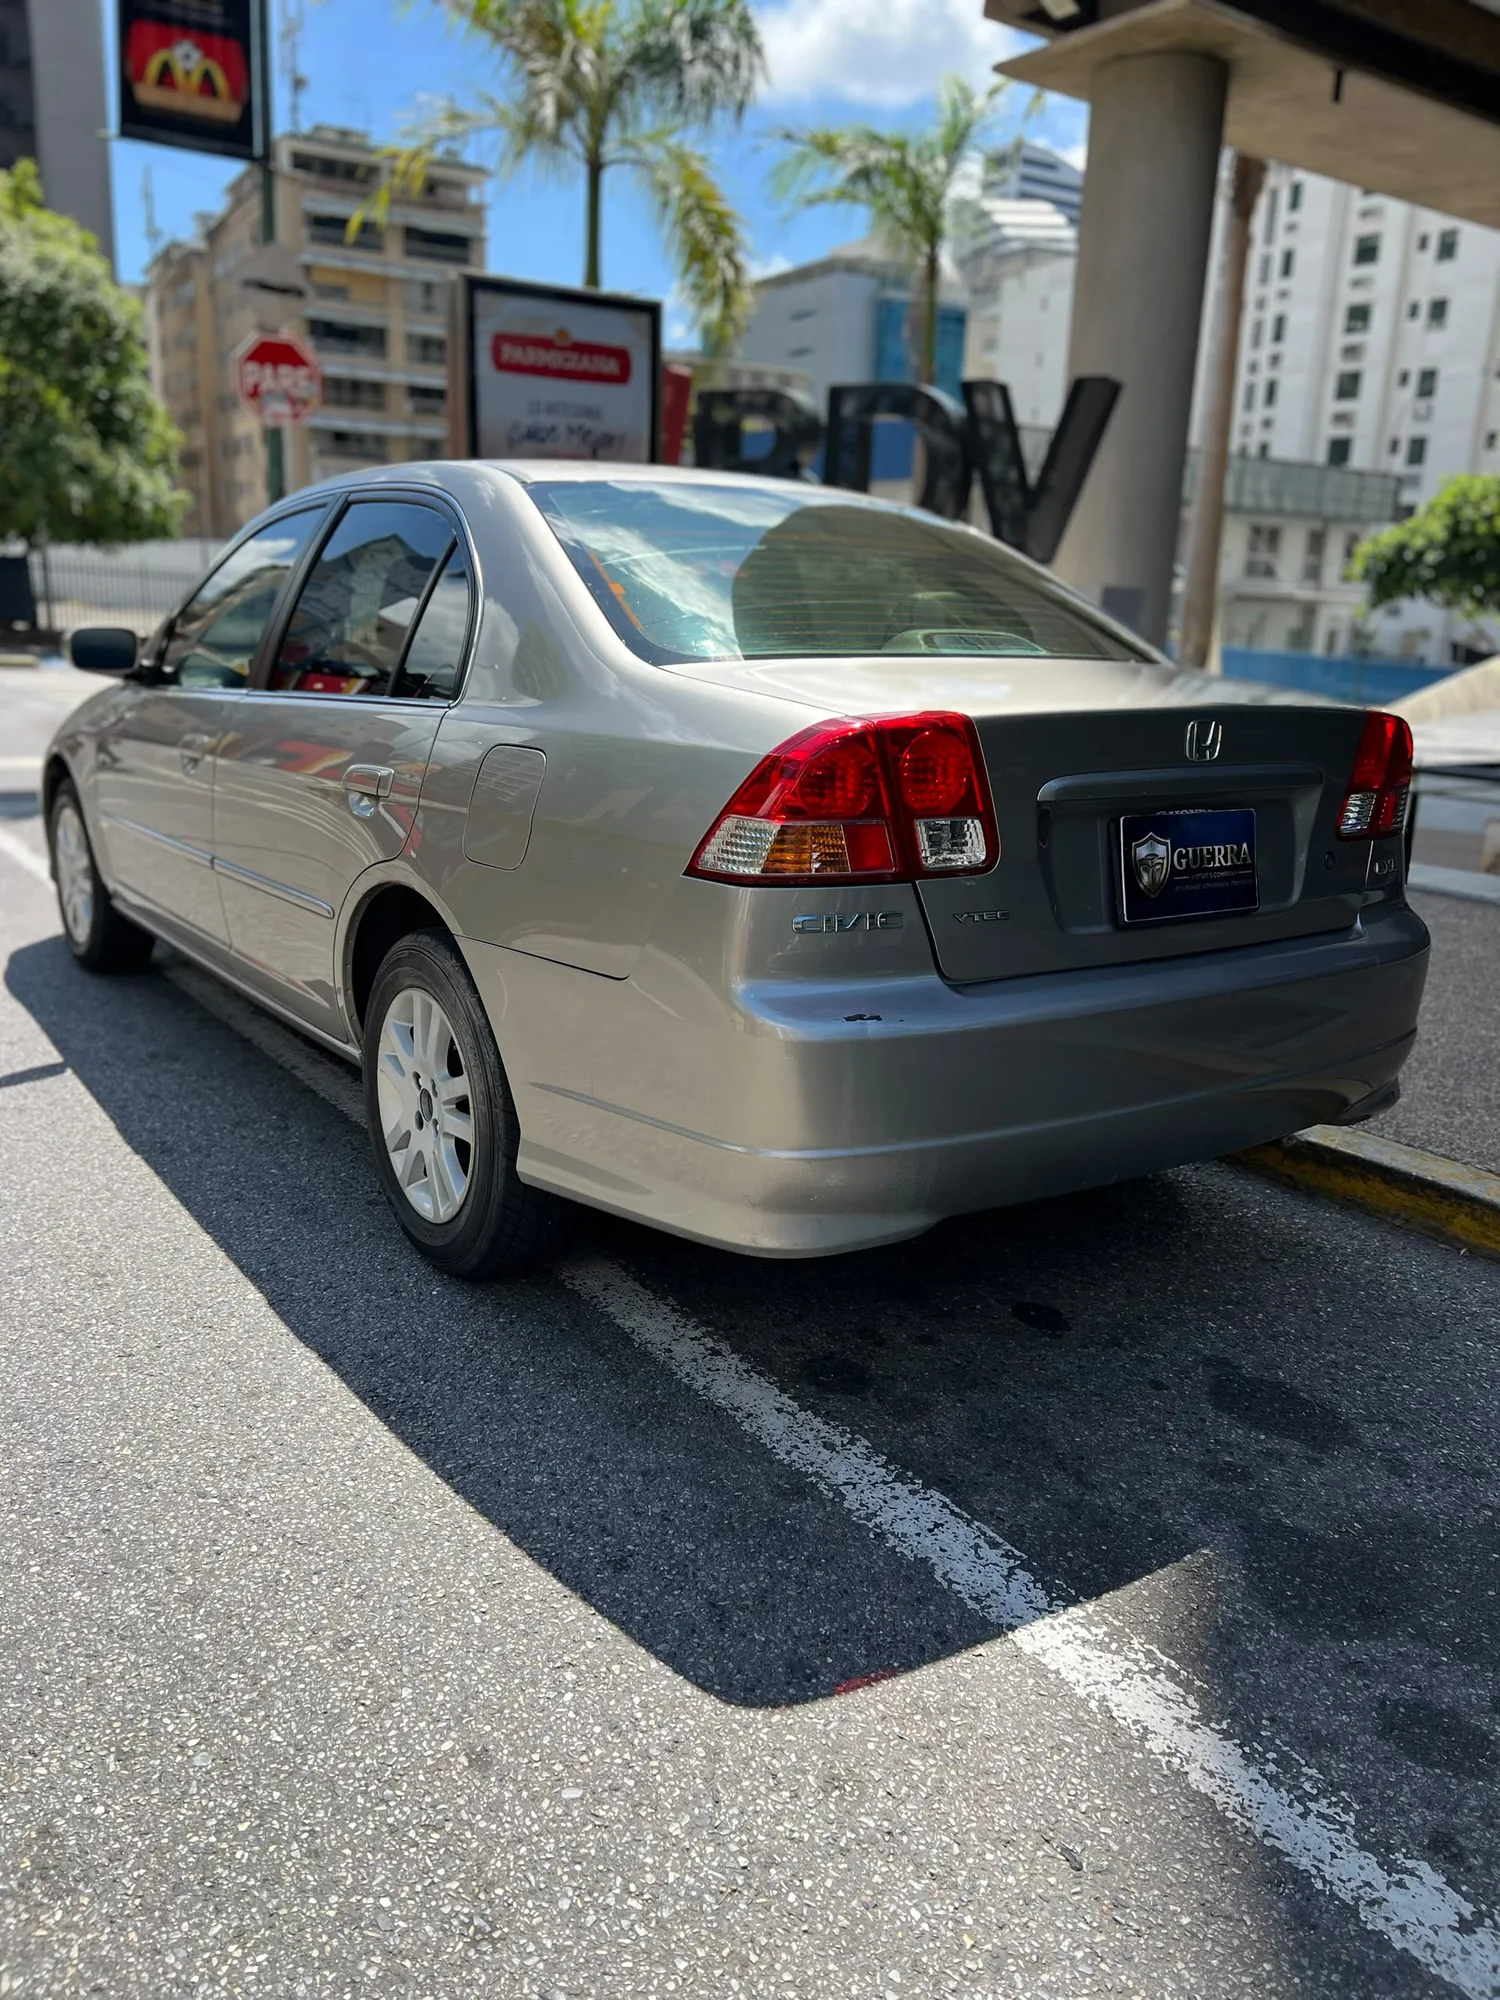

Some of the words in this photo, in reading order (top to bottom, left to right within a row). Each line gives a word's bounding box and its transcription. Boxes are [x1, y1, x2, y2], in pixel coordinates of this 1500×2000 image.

[1173, 842, 1252, 871] GUERRA
[792, 911, 904, 933] CIVIC
[953, 910, 1010, 923] VTEC
